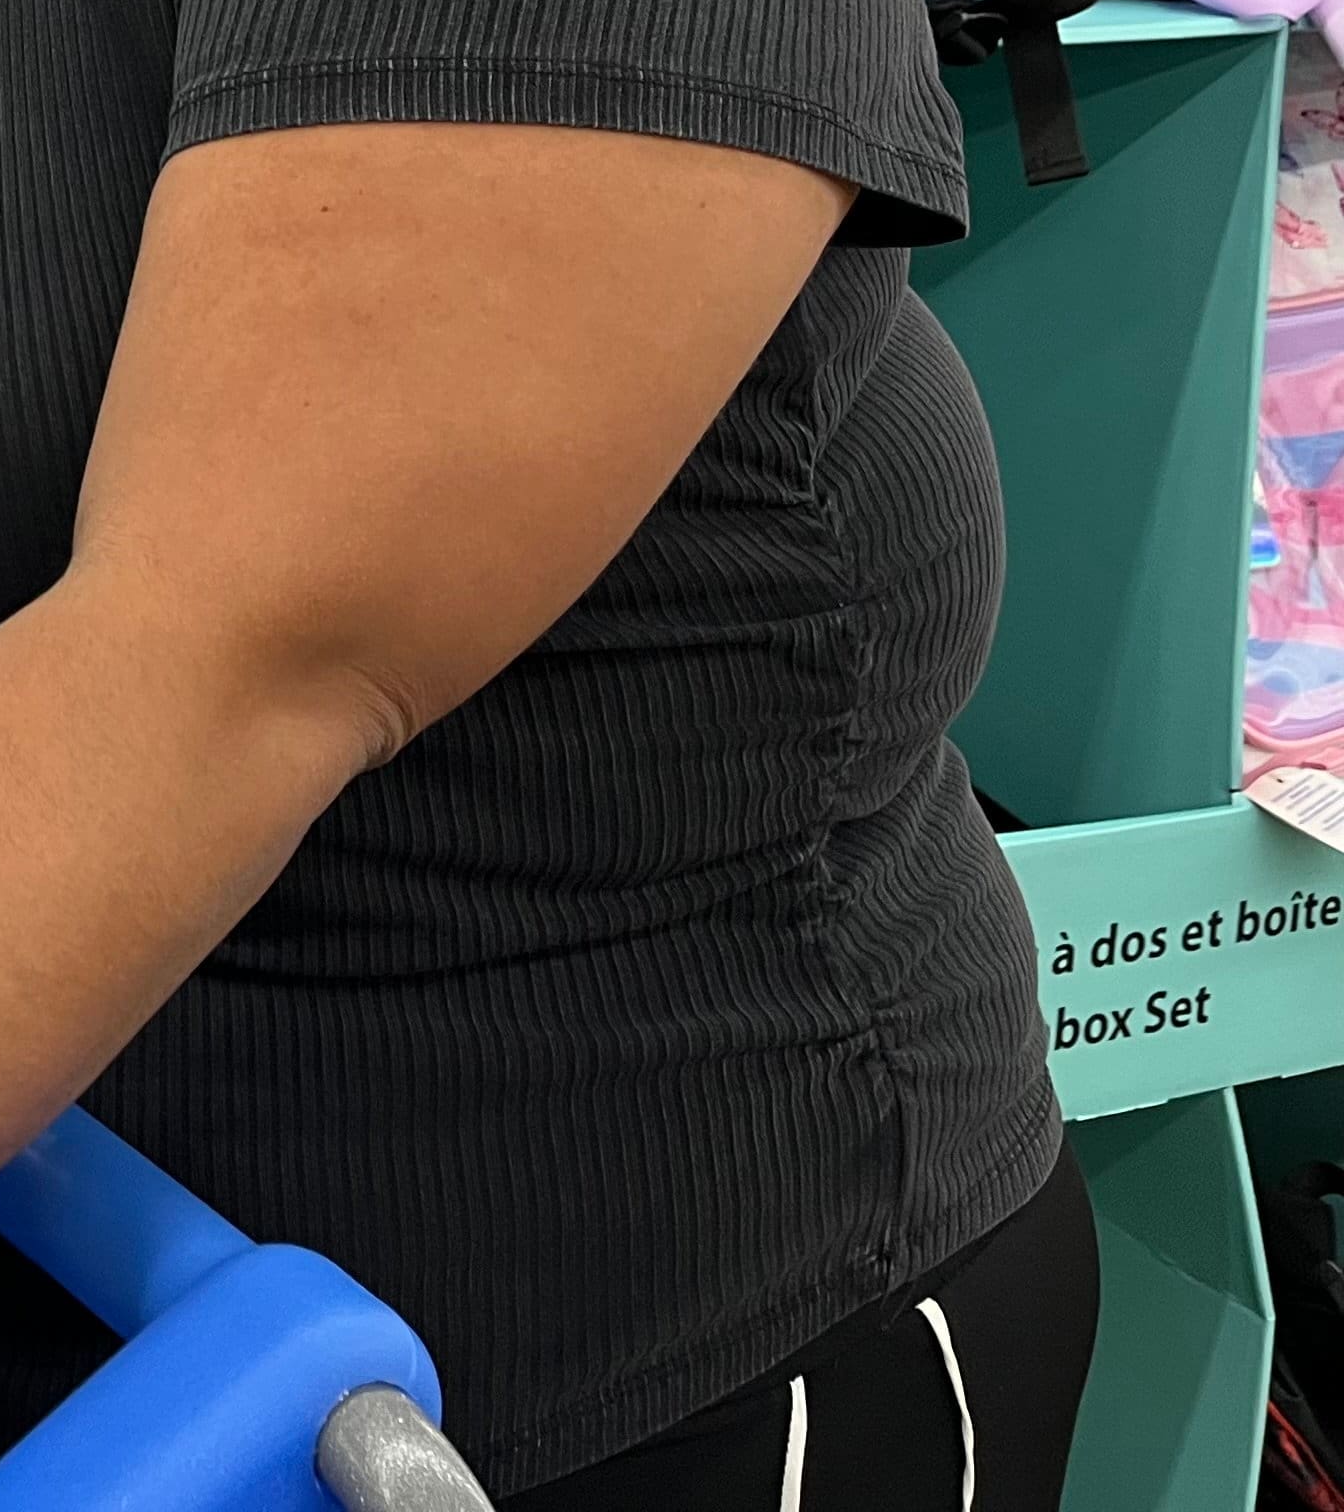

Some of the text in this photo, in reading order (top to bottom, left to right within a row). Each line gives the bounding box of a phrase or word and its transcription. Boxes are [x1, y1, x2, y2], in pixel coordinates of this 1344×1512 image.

[1052, 890, 1342, 975] à dos et boîte
[1054, 987, 1212, 1051] box Set
